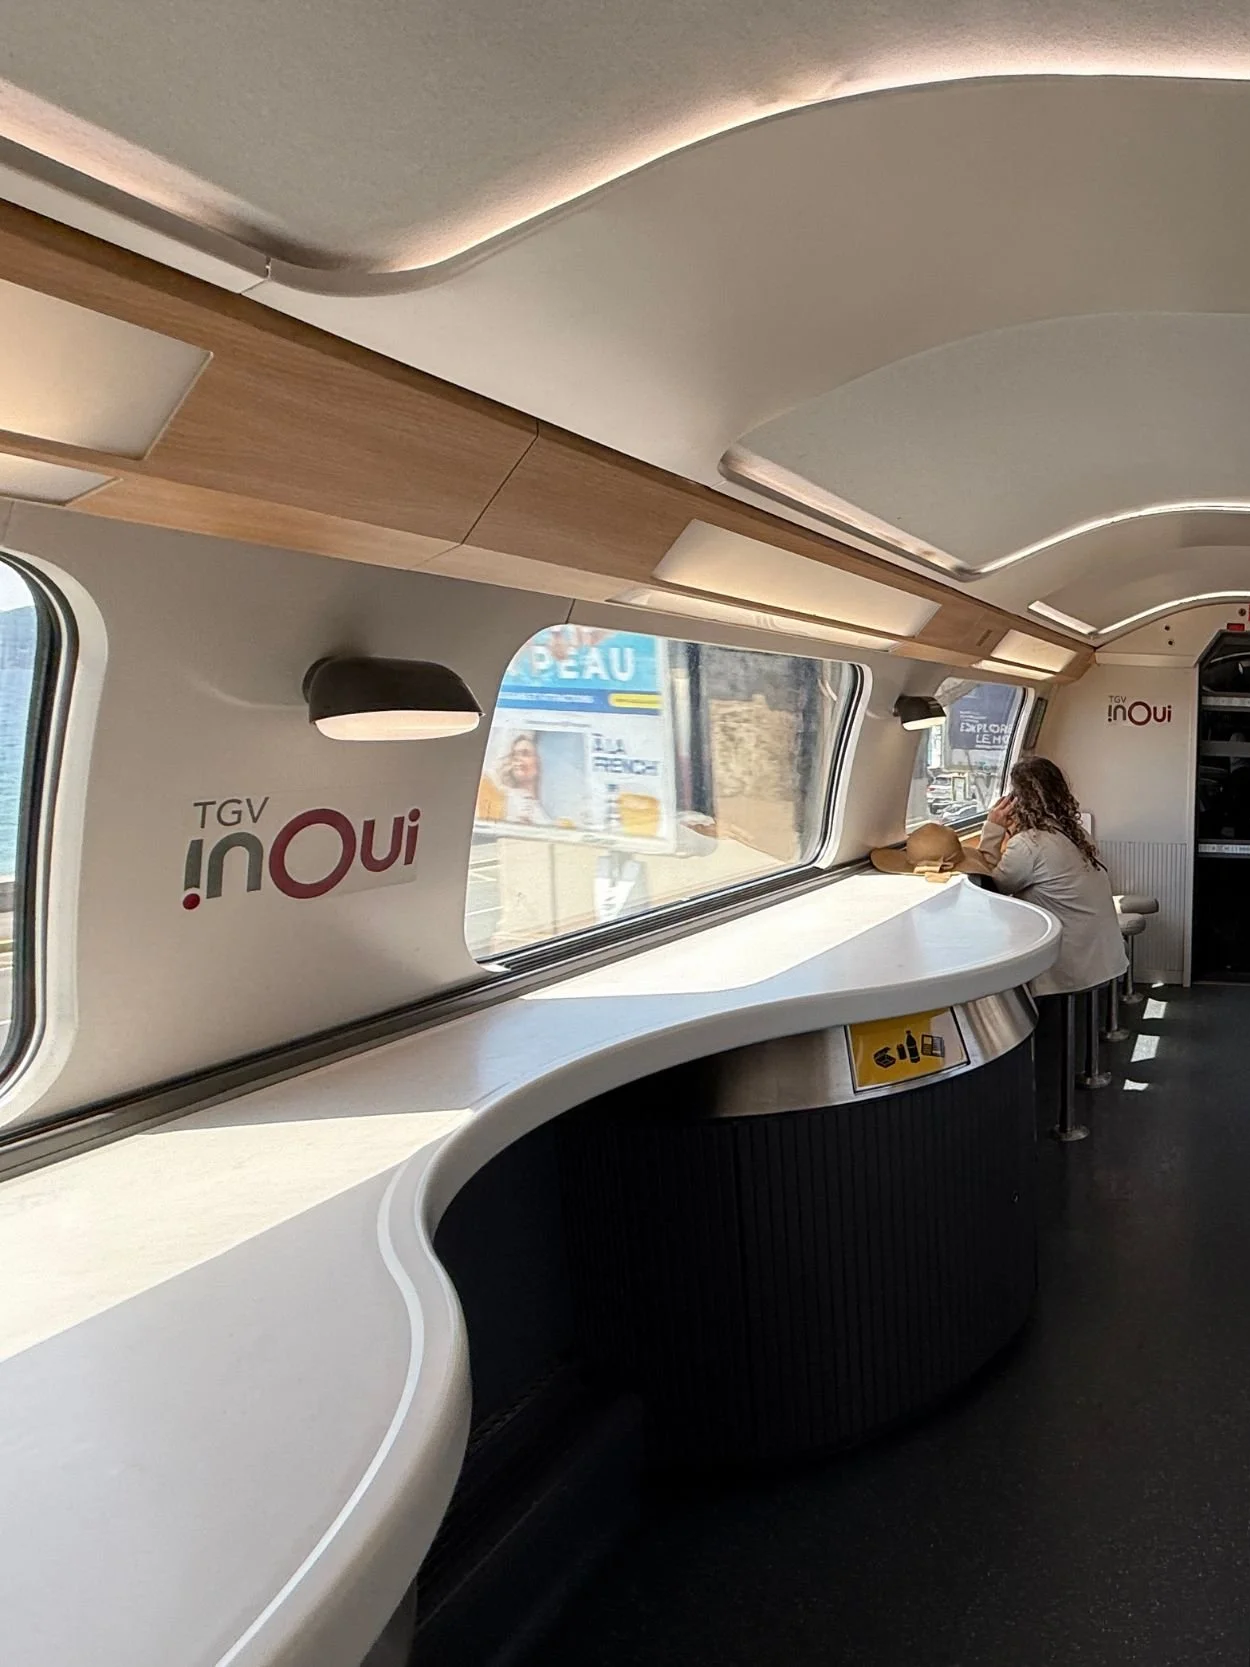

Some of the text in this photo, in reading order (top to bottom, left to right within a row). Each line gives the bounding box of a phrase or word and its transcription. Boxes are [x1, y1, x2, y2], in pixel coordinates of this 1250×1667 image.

[531, 645, 636, 682] PEAU
[1109, 695, 1127, 704] TGV
[193, 796, 270, 829] TGV
